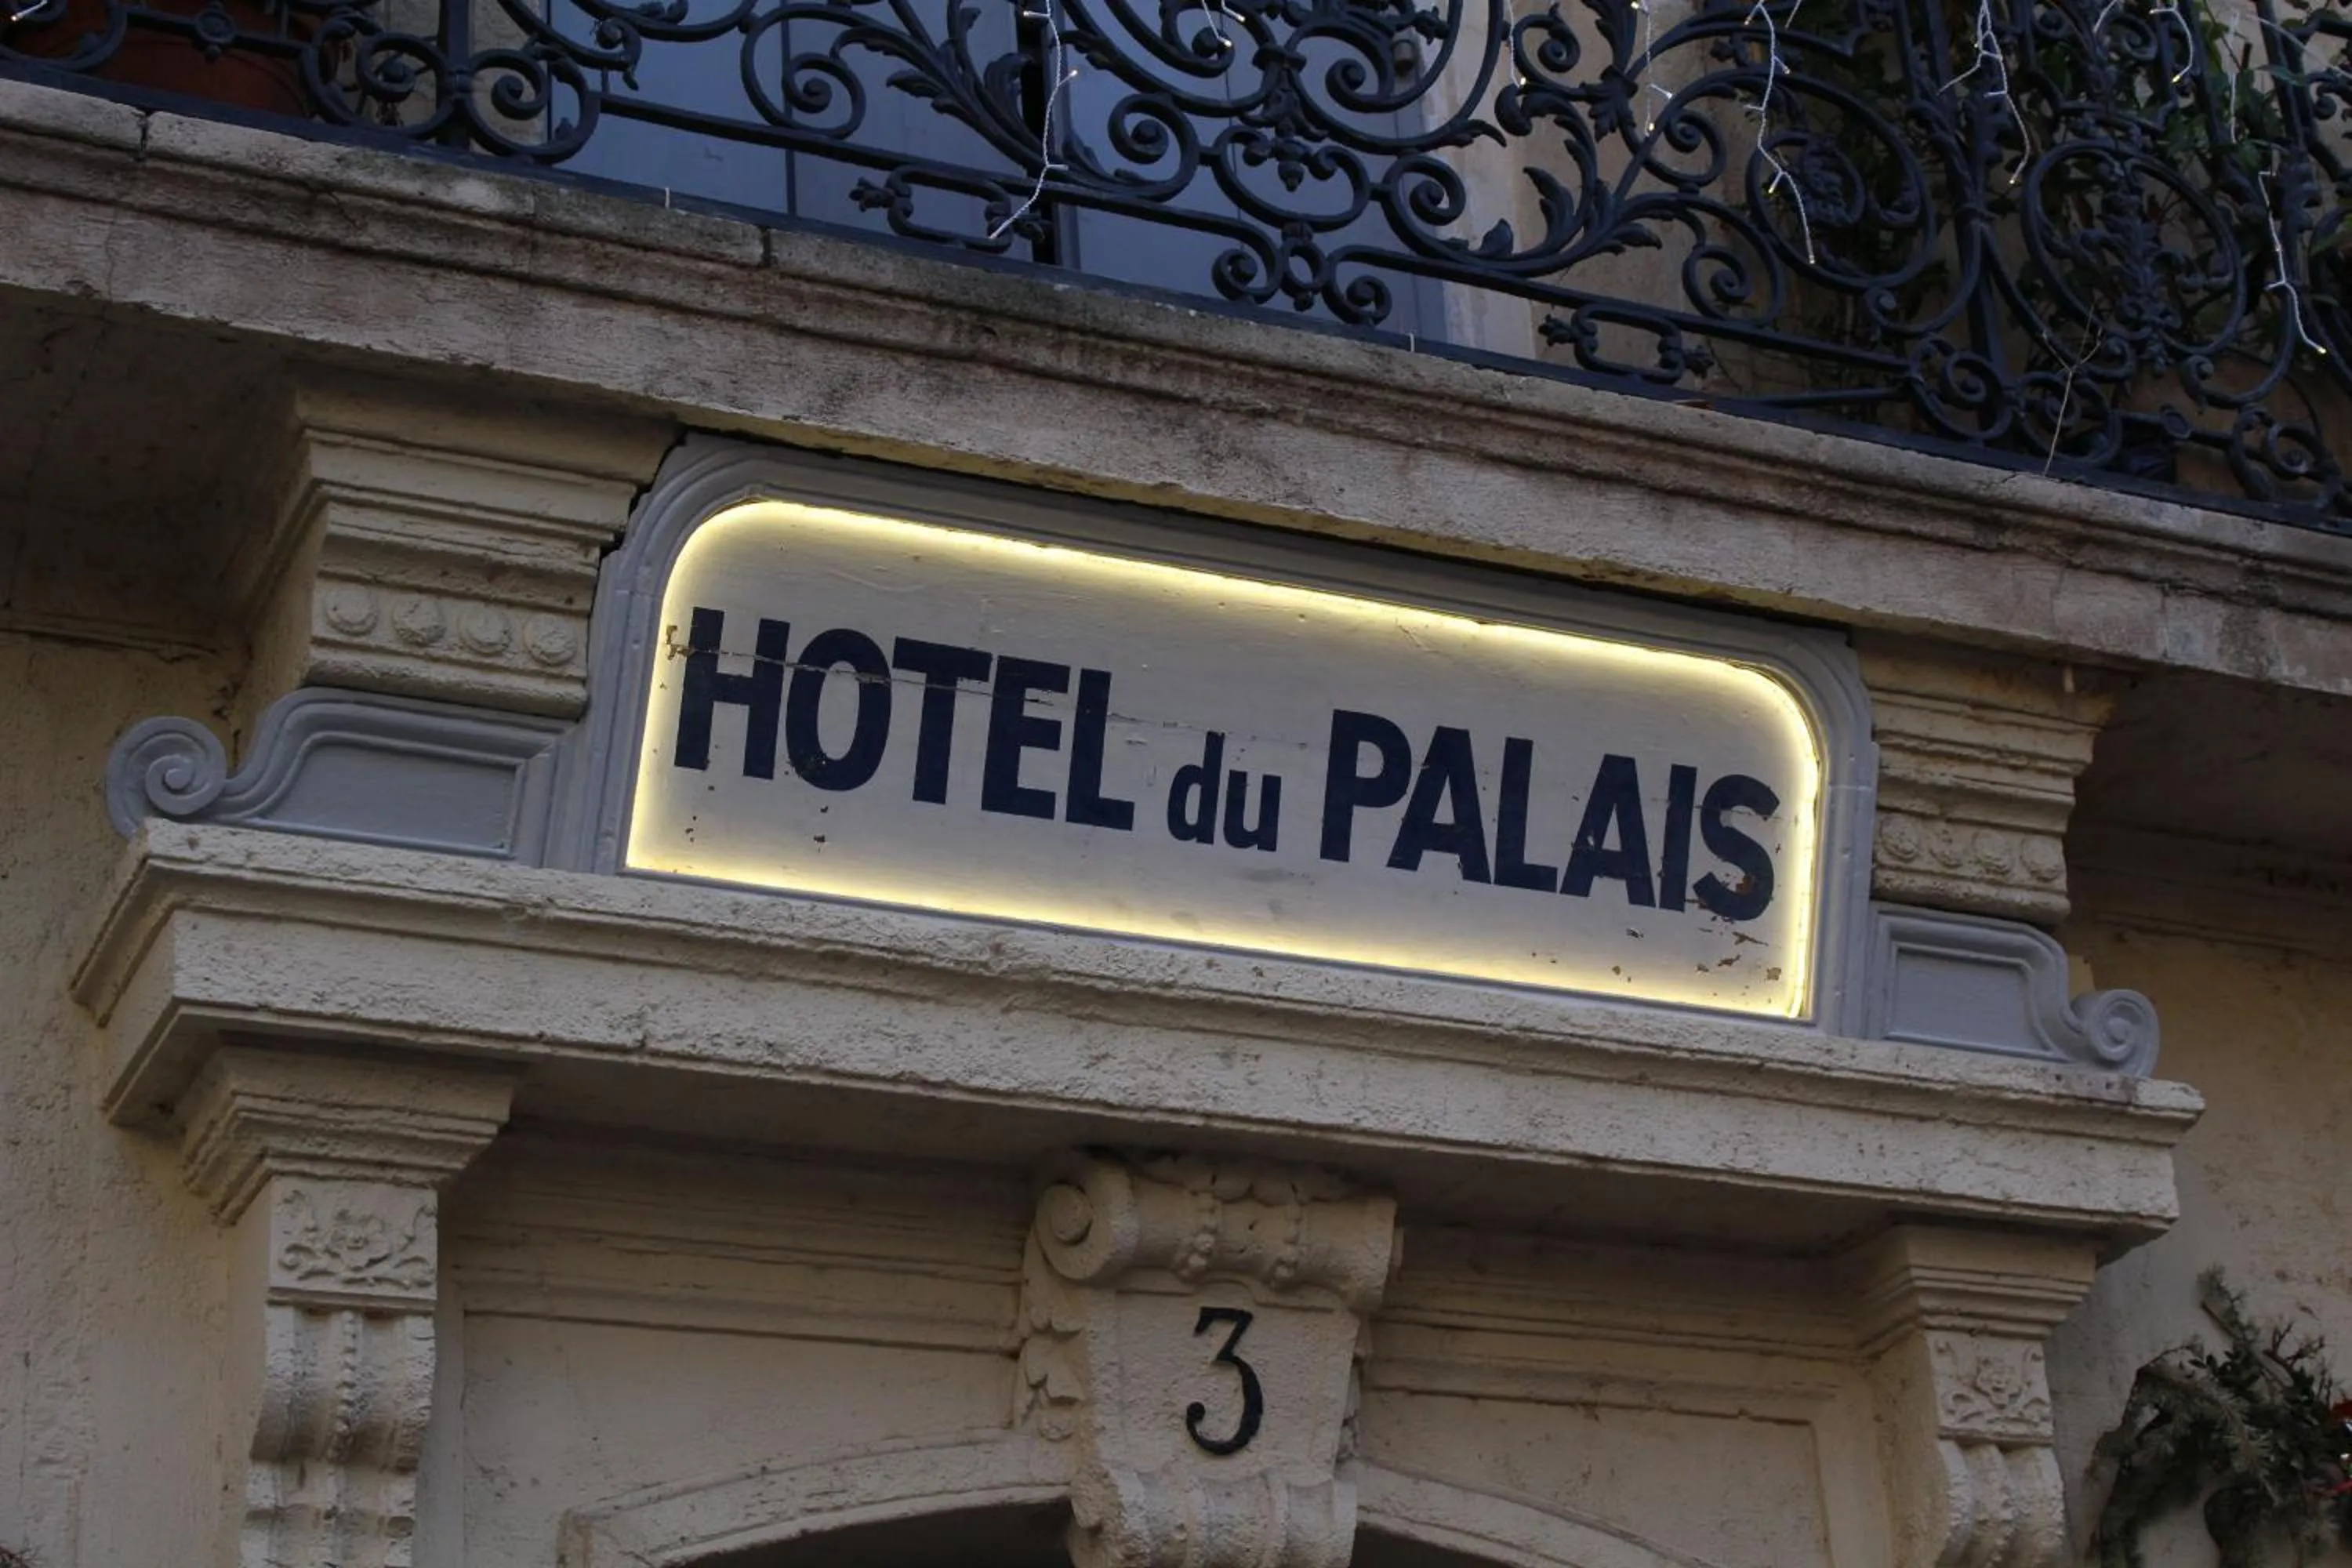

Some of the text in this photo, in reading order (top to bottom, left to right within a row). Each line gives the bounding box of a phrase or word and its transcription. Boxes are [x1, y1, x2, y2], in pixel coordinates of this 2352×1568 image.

[674, 606, 1780, 924] HOTEL du PALAIS
[1186, 1307, 1263, 1455] 3
